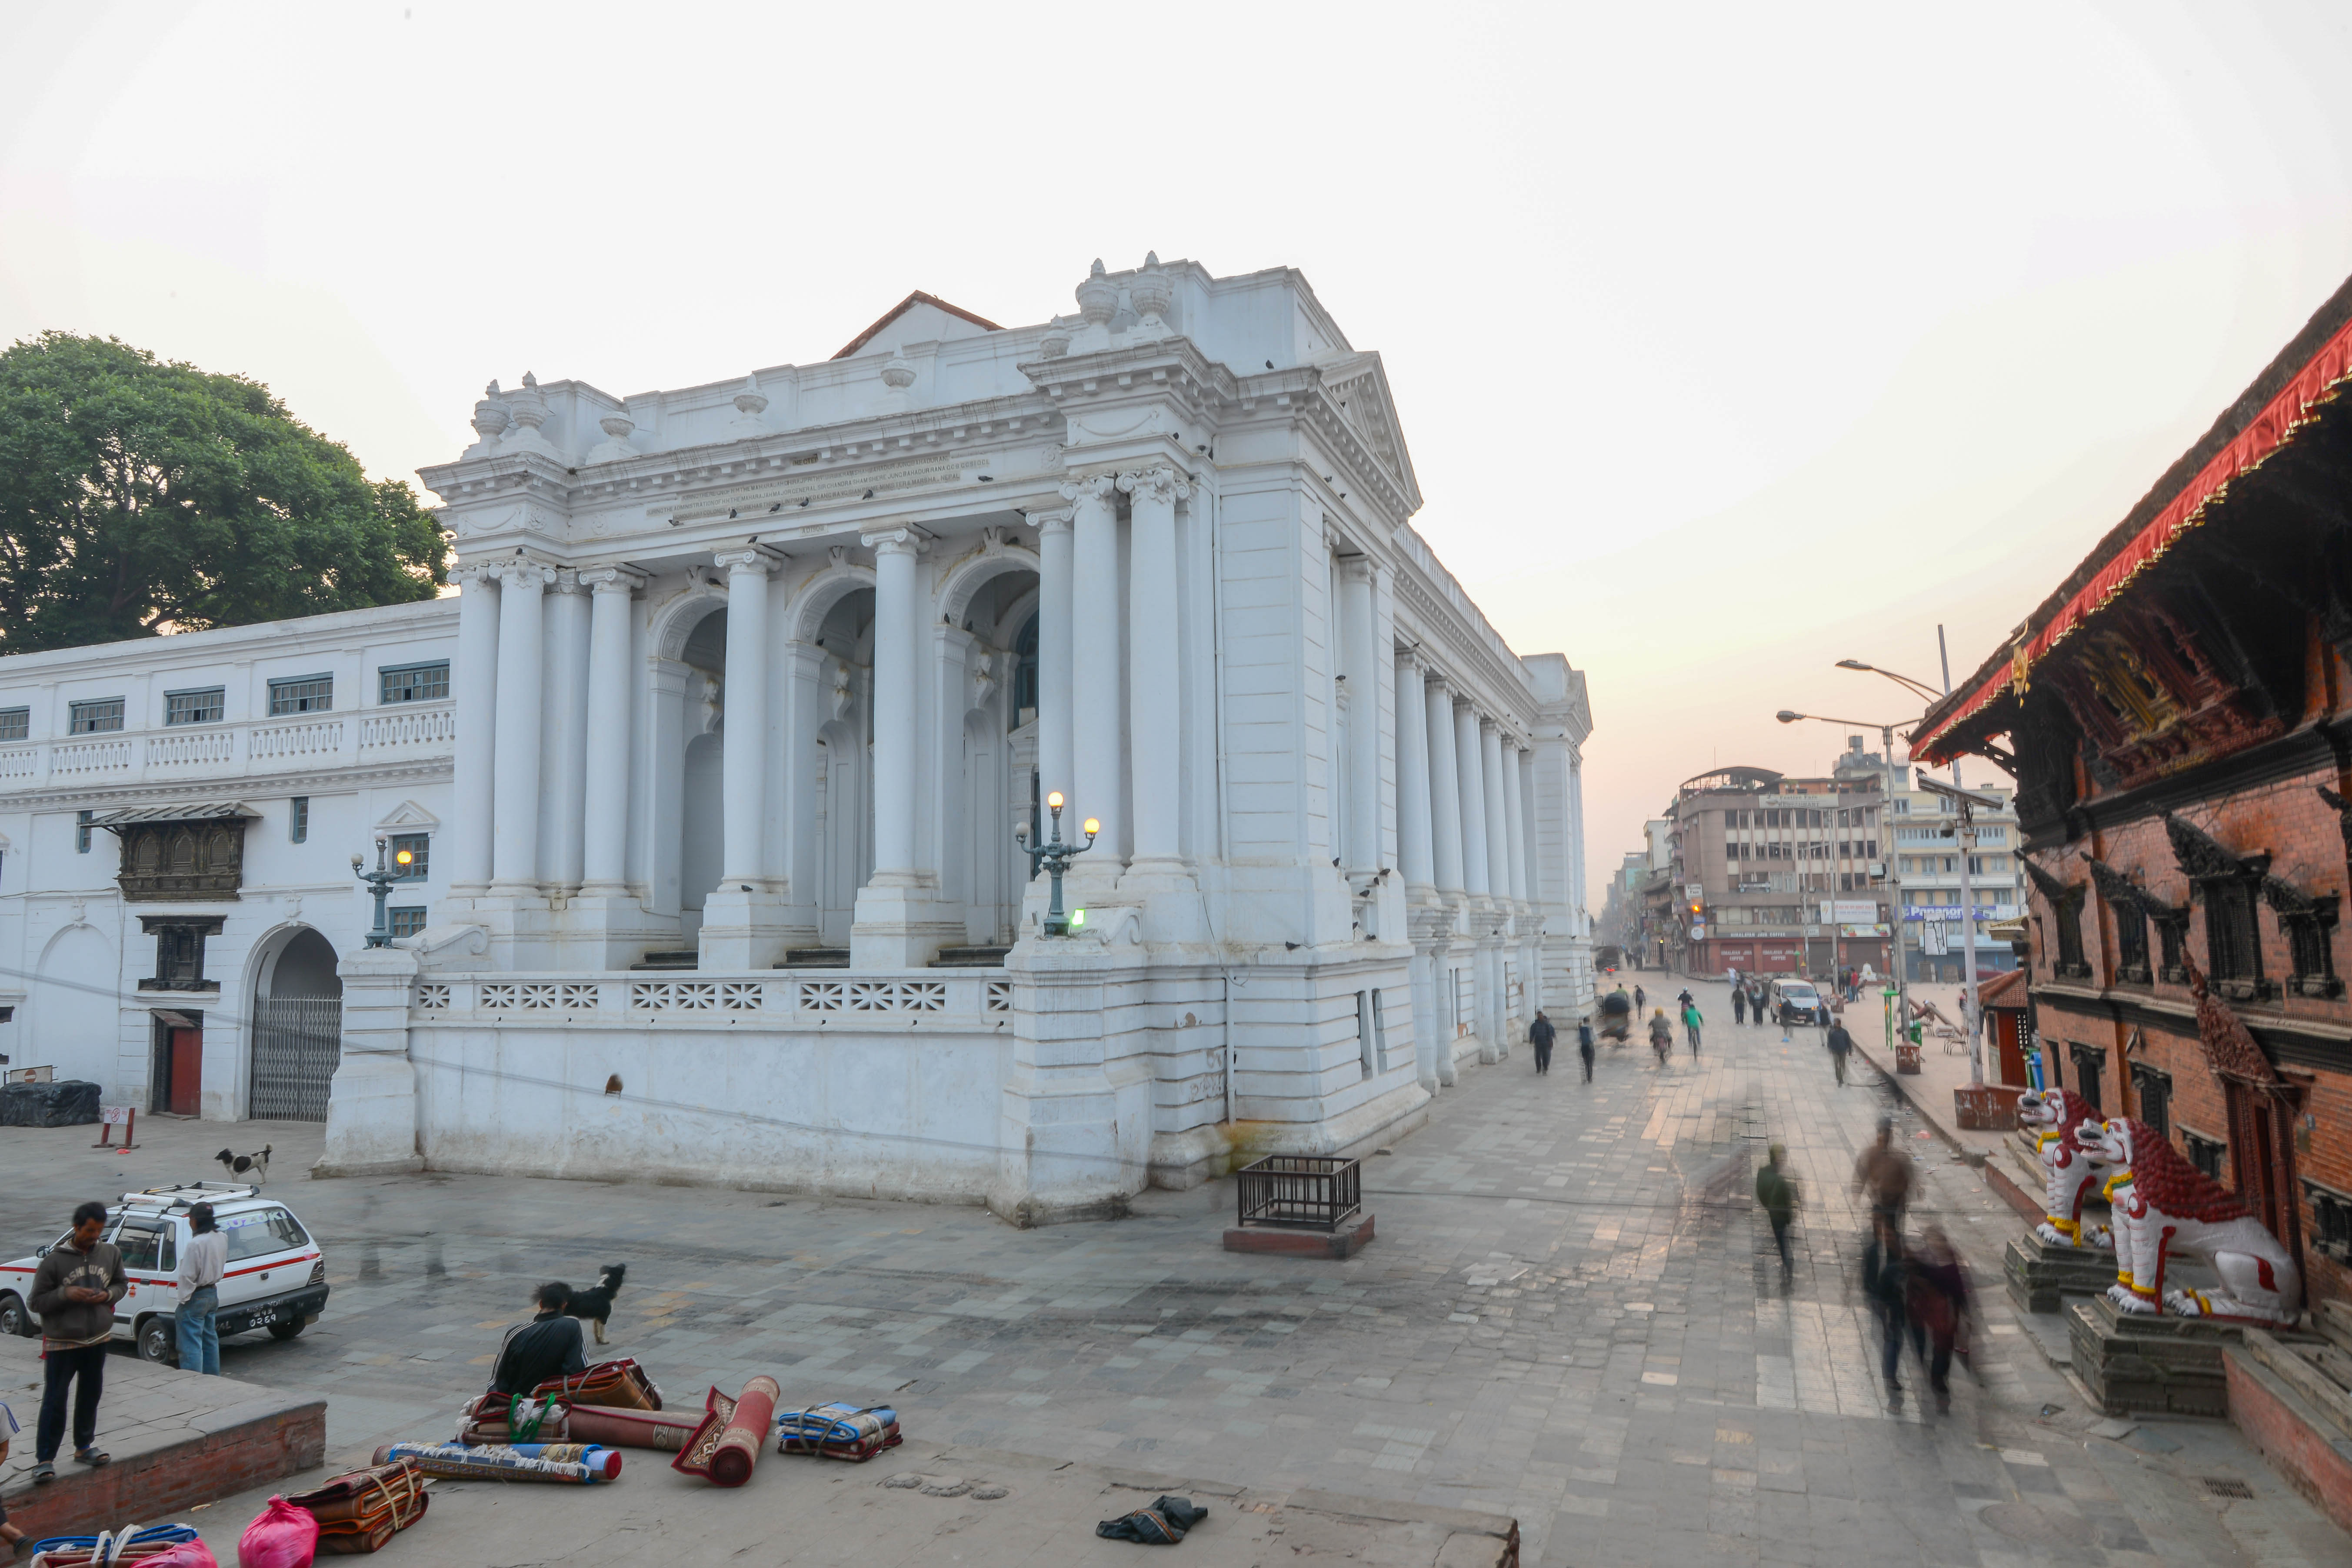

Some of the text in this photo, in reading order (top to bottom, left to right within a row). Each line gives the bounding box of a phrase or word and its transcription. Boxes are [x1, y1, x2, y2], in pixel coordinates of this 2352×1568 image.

[674, 499, 714, 511] ADMINISTRATION
[741, 491, 772, 501] MAHARAJAH
[773, 488, 791, 496] MAJOR
[792, 484, 816, 493] GENERAL
[826, 479, 851, 488] CHANDRA
[903, 467, 929, 477] BAHADUR
[929, 465, 946, 473] RANA
[703, 507, 726, 516] COLONEL
[940, 473, 960, 481] NEPAL
[217, 1211, 288, 1231] SUZUKI
